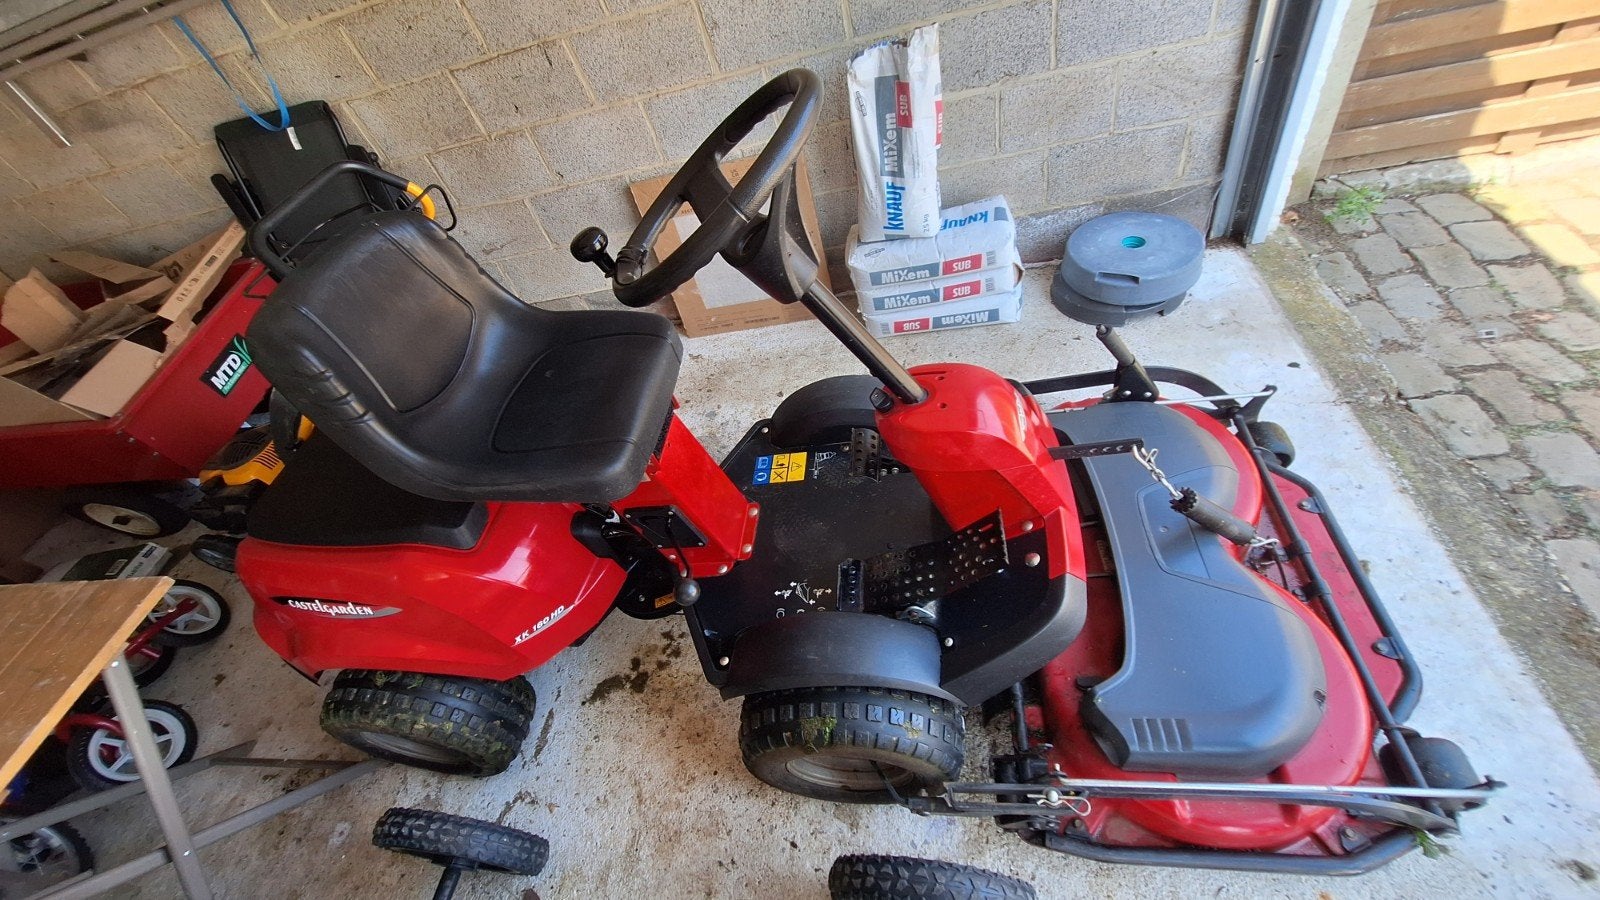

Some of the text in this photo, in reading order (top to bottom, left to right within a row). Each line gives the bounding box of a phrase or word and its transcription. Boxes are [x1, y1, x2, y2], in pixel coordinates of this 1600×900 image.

[900, 94, 909, 116] SUB
[883, 112, 906, 231] KNAUF MiXem
[940, 210, 989, 231] KNAUF
[881, 260, 971, 284] MiXem SUB
[884, 285, 971, 309] MiXem SUB
[903, 311, 989, 331] MiXem SUB
[210, 353, 241, 390] MTD
[514, 630, 530, 645] XK
